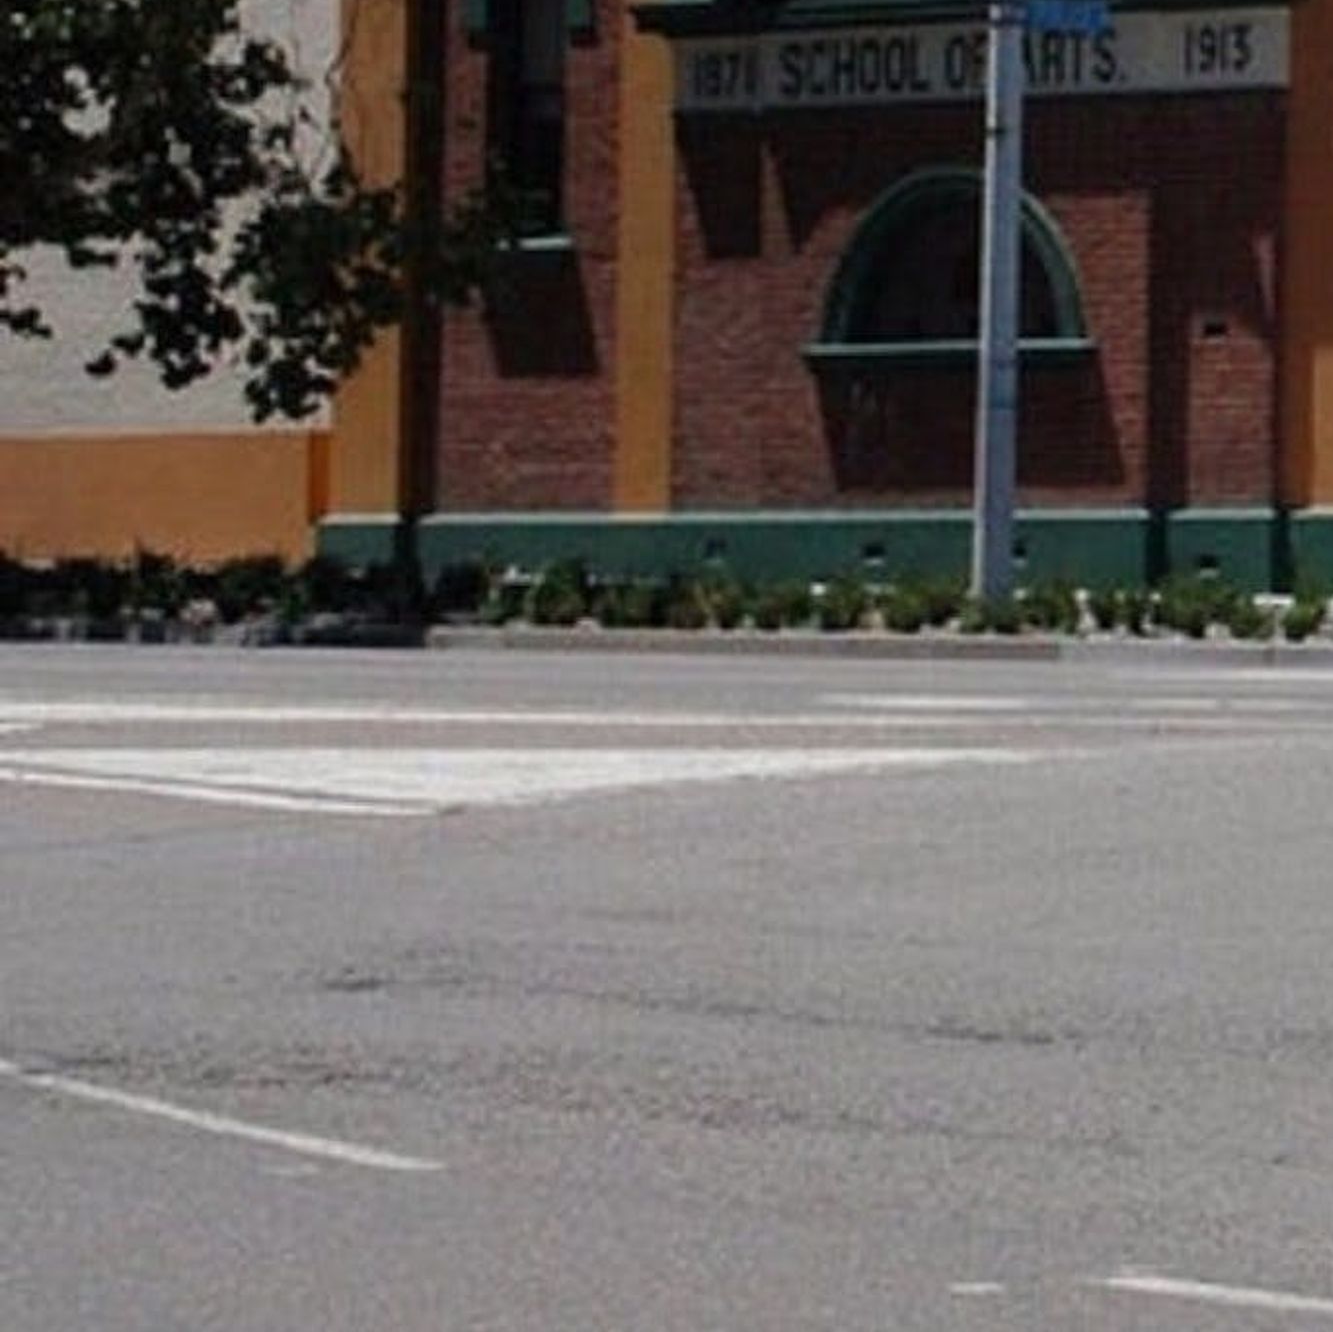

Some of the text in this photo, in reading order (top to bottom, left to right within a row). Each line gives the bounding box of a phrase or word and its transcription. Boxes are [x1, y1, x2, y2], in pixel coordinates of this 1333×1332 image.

[778, 36, 931, 96] SCHOOL
[943, 30, 989, 90] OF
[1183, 22, 1253, 75] 1913
